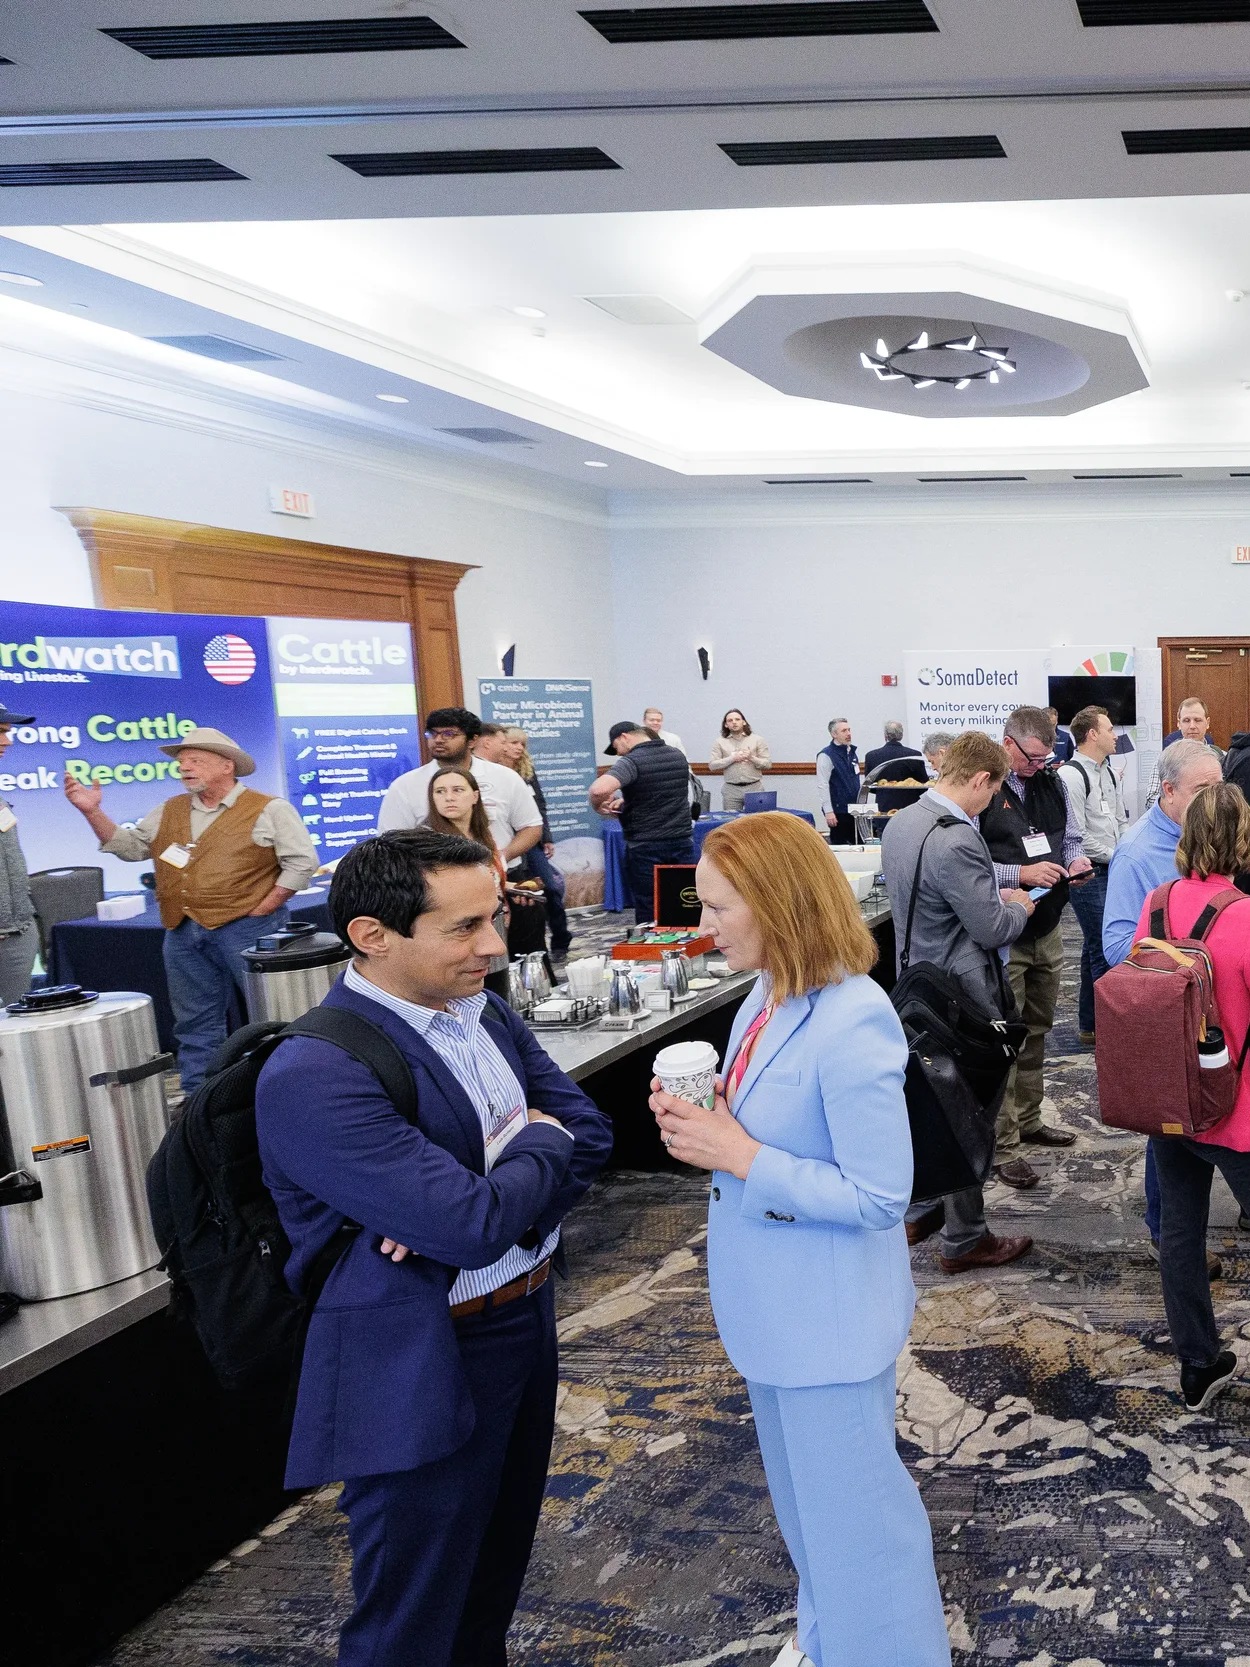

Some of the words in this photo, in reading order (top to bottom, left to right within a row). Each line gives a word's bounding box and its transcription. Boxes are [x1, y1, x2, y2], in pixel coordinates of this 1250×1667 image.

[283, 490, 309, 514] EXIT
[277, 634, 407, 665] Cattle
[279, 664, 297, 676] by
[936, 667, 1018, 686] SomaDetect
[492, 701, 518, 710] Your
[520, 701, 583, 710] Microbiome
[920, 702, 966, 712] Monitor
[967, 703, 1000, 714] every
[492, 711, 534, 719] Partner
[535, 711, 546, 719] in
[548, 710, 585, 719] Animal
[87, 713, 197, 742] Cattle
[522, 720, 580, 729] Agriculture
[920, 716, 931, 725] at
[934, 717, 966, 727] every
